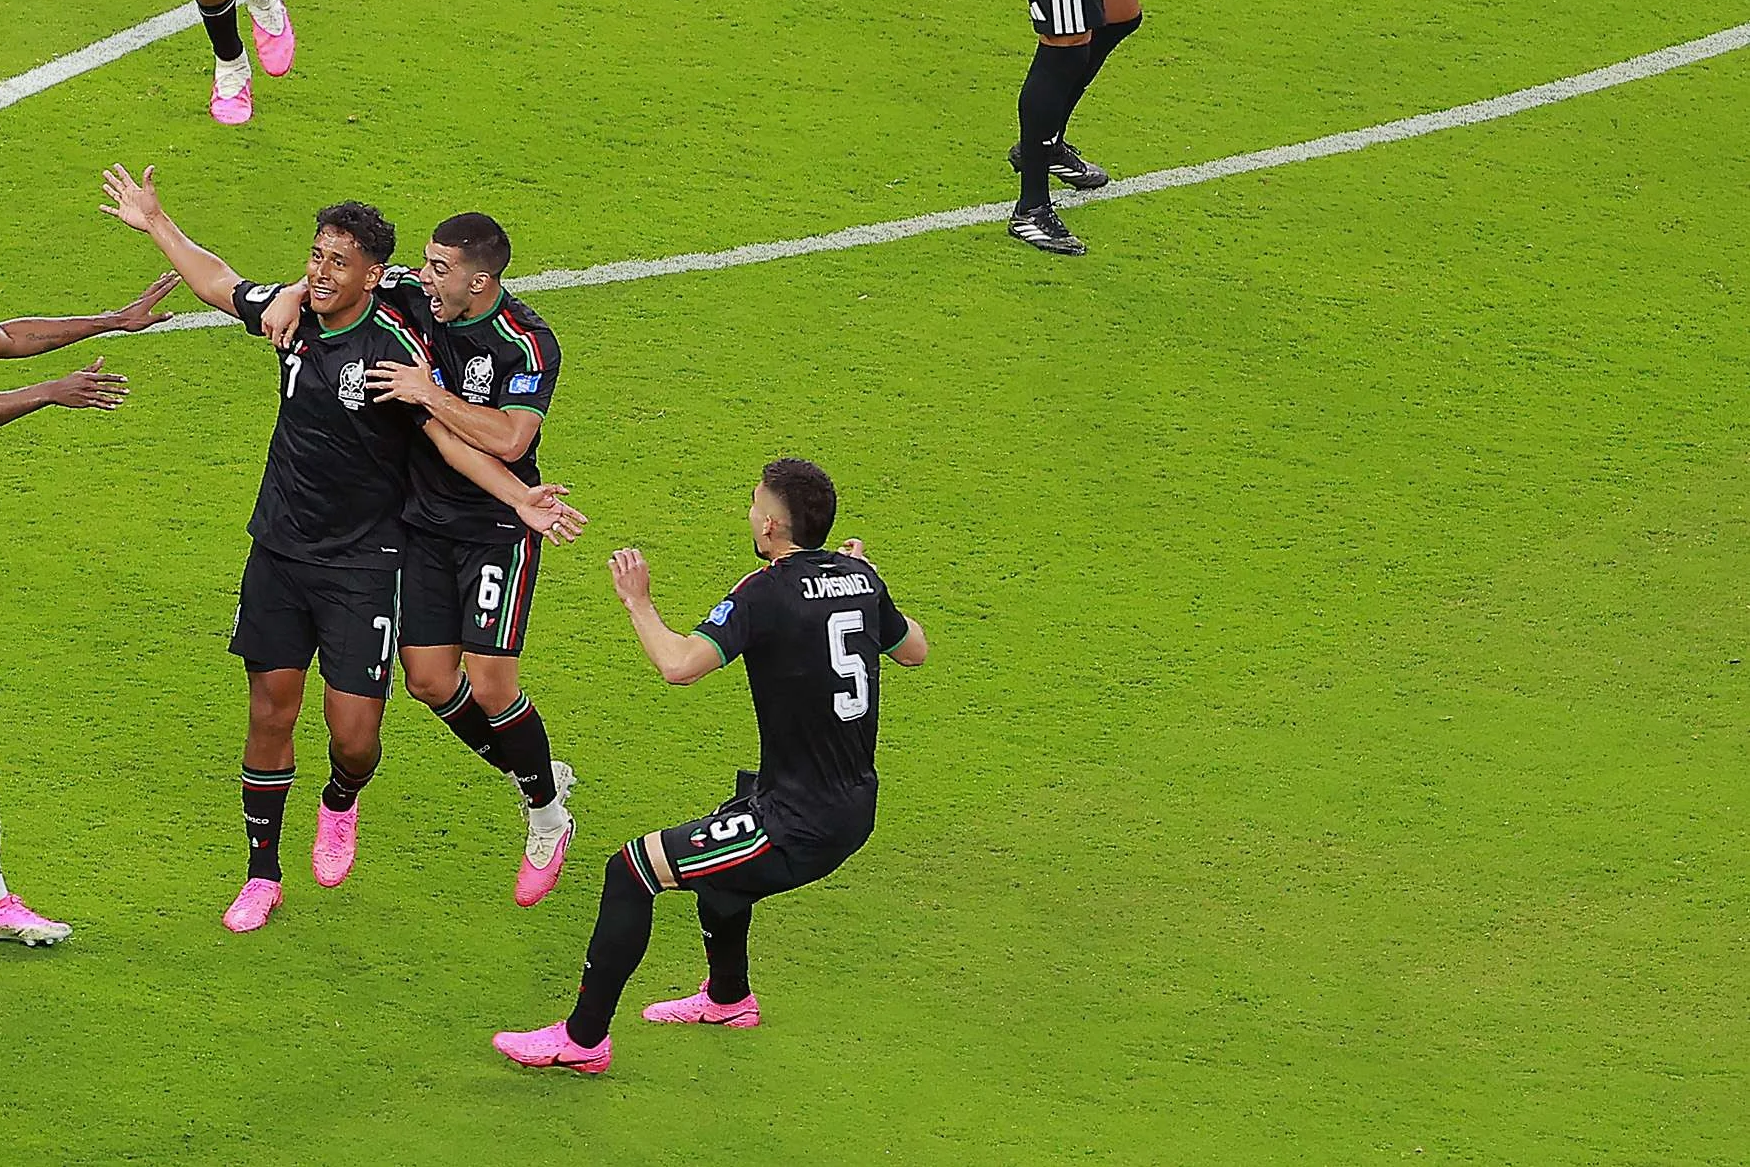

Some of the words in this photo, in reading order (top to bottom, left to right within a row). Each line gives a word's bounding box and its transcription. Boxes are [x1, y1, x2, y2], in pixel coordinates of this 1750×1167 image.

[285, 354, 302, 399] 7
[478, 564, 504, 611] 6
[373, 616, 391, 662] 7
[827, 610, 870, 722] 5
[710, 814, 756, 842] 5
